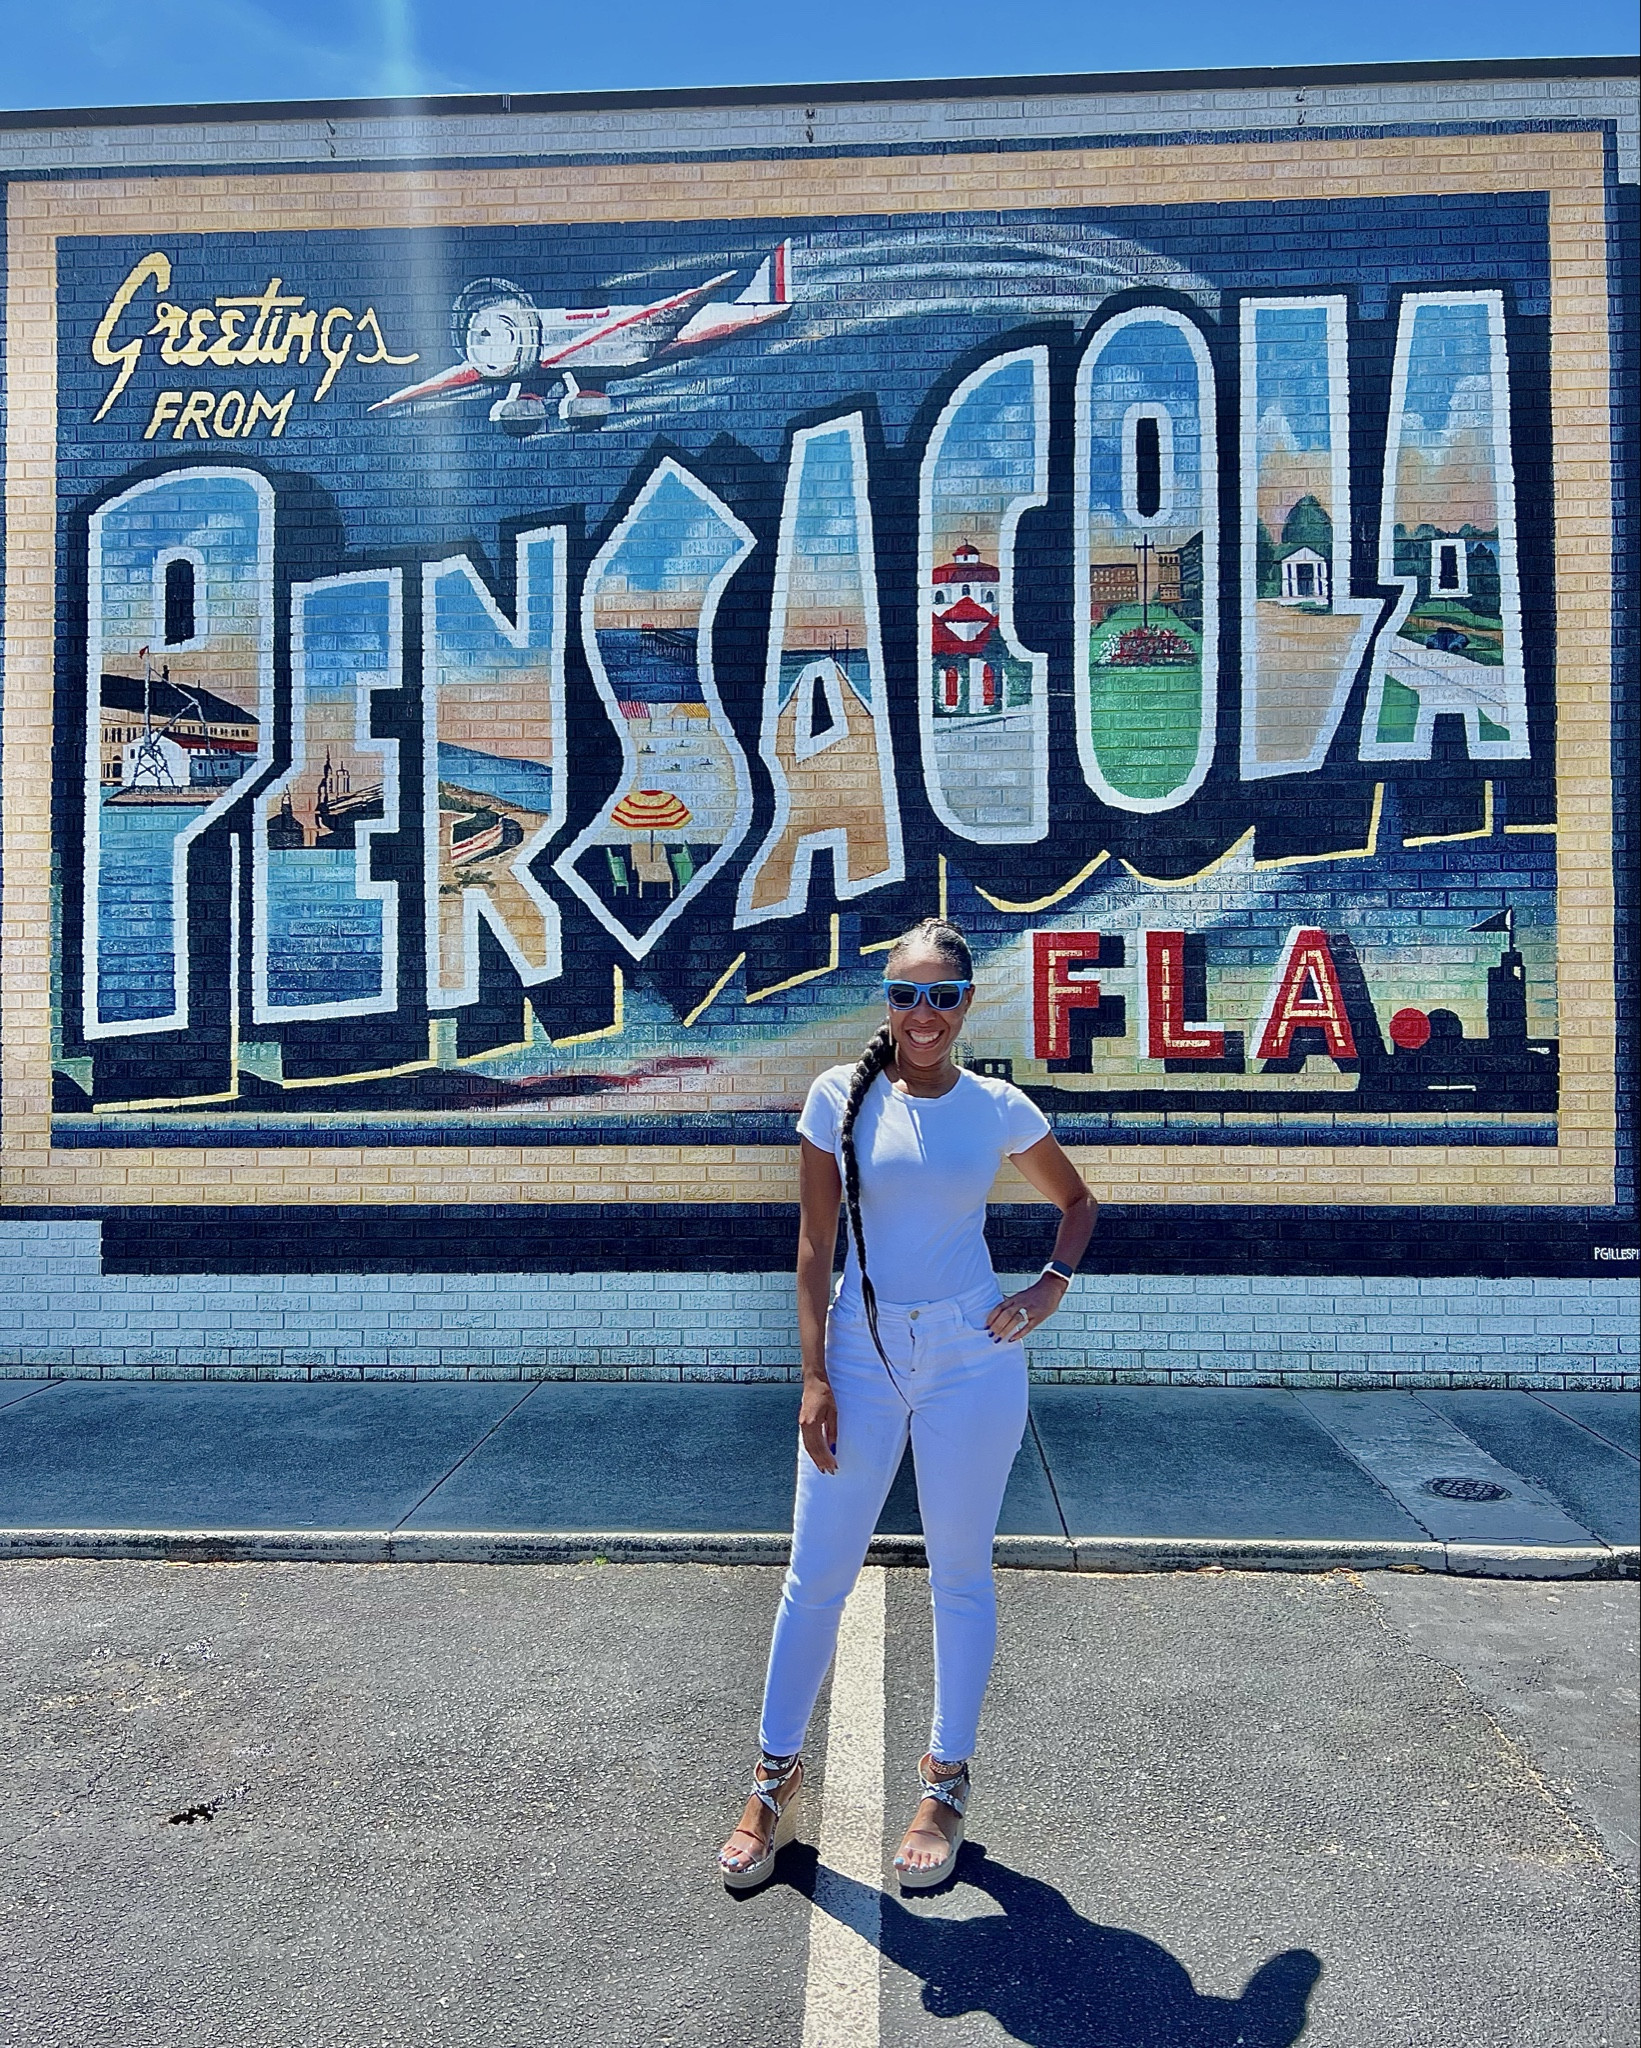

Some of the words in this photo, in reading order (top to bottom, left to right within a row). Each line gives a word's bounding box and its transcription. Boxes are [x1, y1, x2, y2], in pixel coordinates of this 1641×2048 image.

[92, 251, 420, 423] Greetings
[143, 388, 296, 440] FROM
[82, 288, 1531, 1042] PENSACOLA
[1026, 924, 1430, 1060] FLA.
[1594, 1246, 1641, 1261] PGILLESPI
